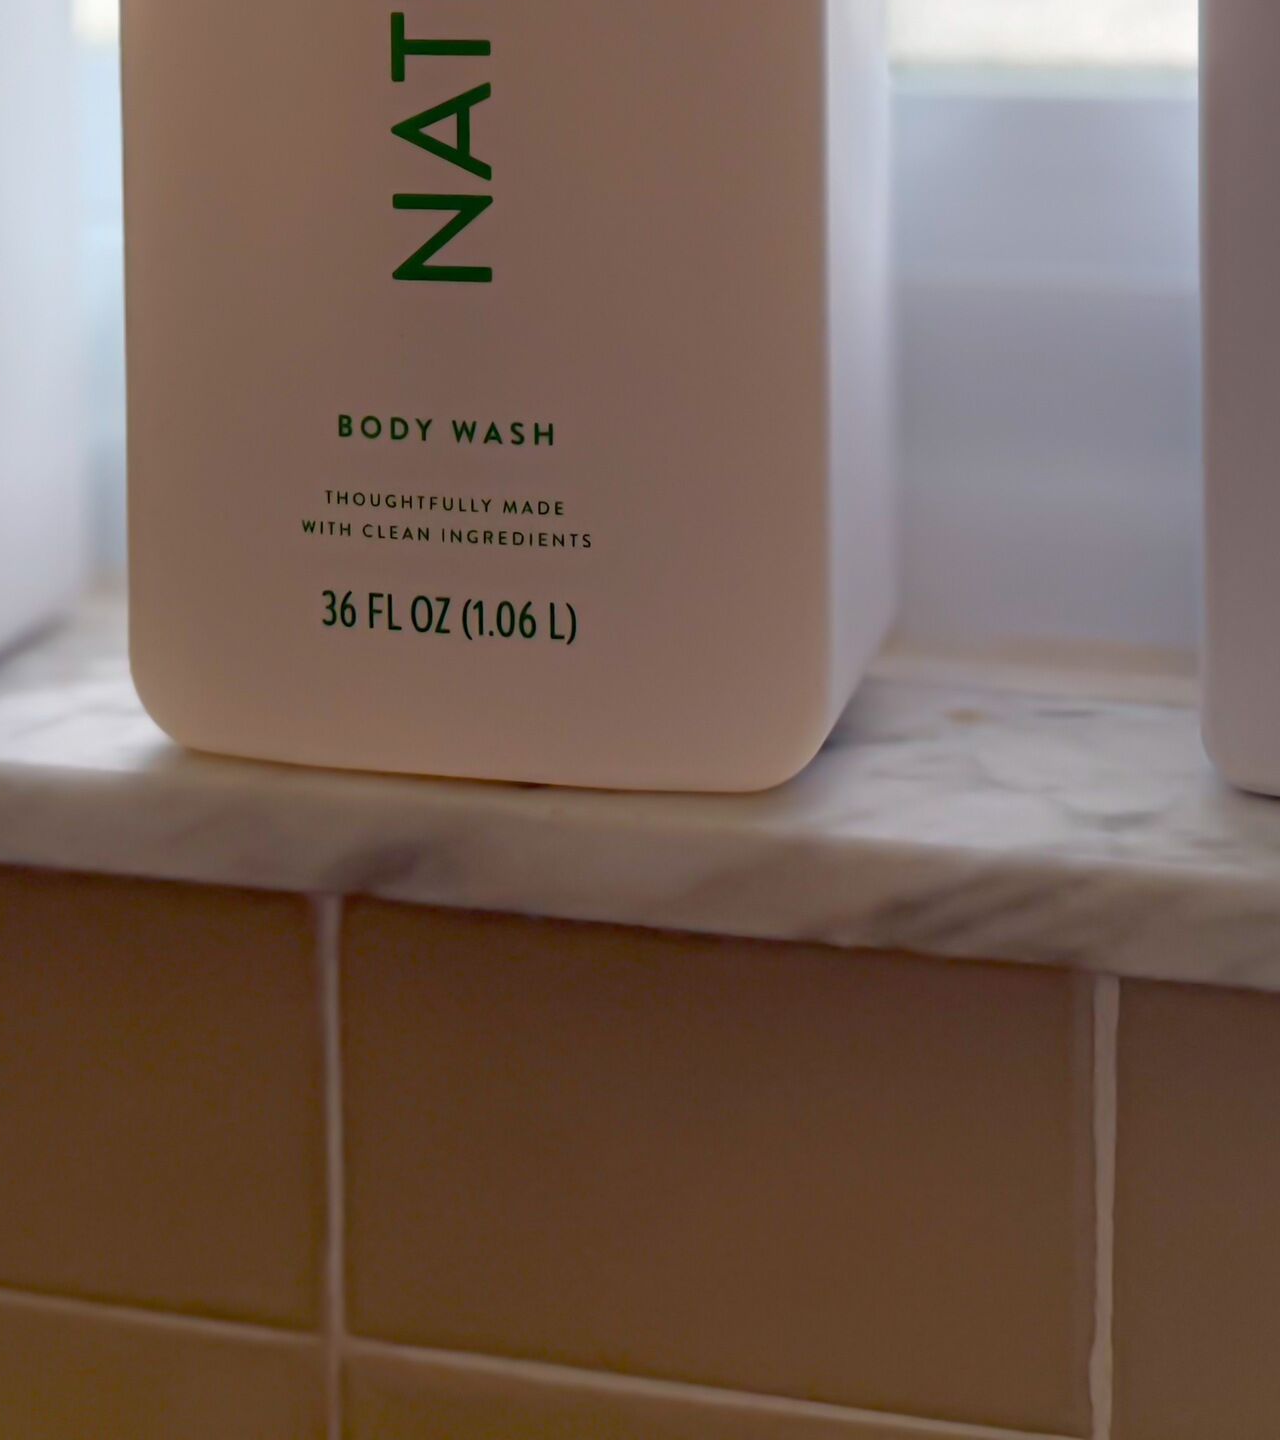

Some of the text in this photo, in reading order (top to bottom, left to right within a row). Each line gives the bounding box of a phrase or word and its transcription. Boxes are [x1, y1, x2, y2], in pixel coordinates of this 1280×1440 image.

[337, 413, 555, 447] BODY WASH
[325, 489, 564, 517] THOUGHTFULLY MADE
[301, 519, 592, 549] WITH CLEAN INGREDIENTS
[322, 589, 578, 645] 36 FL OZ (1.06 L)
